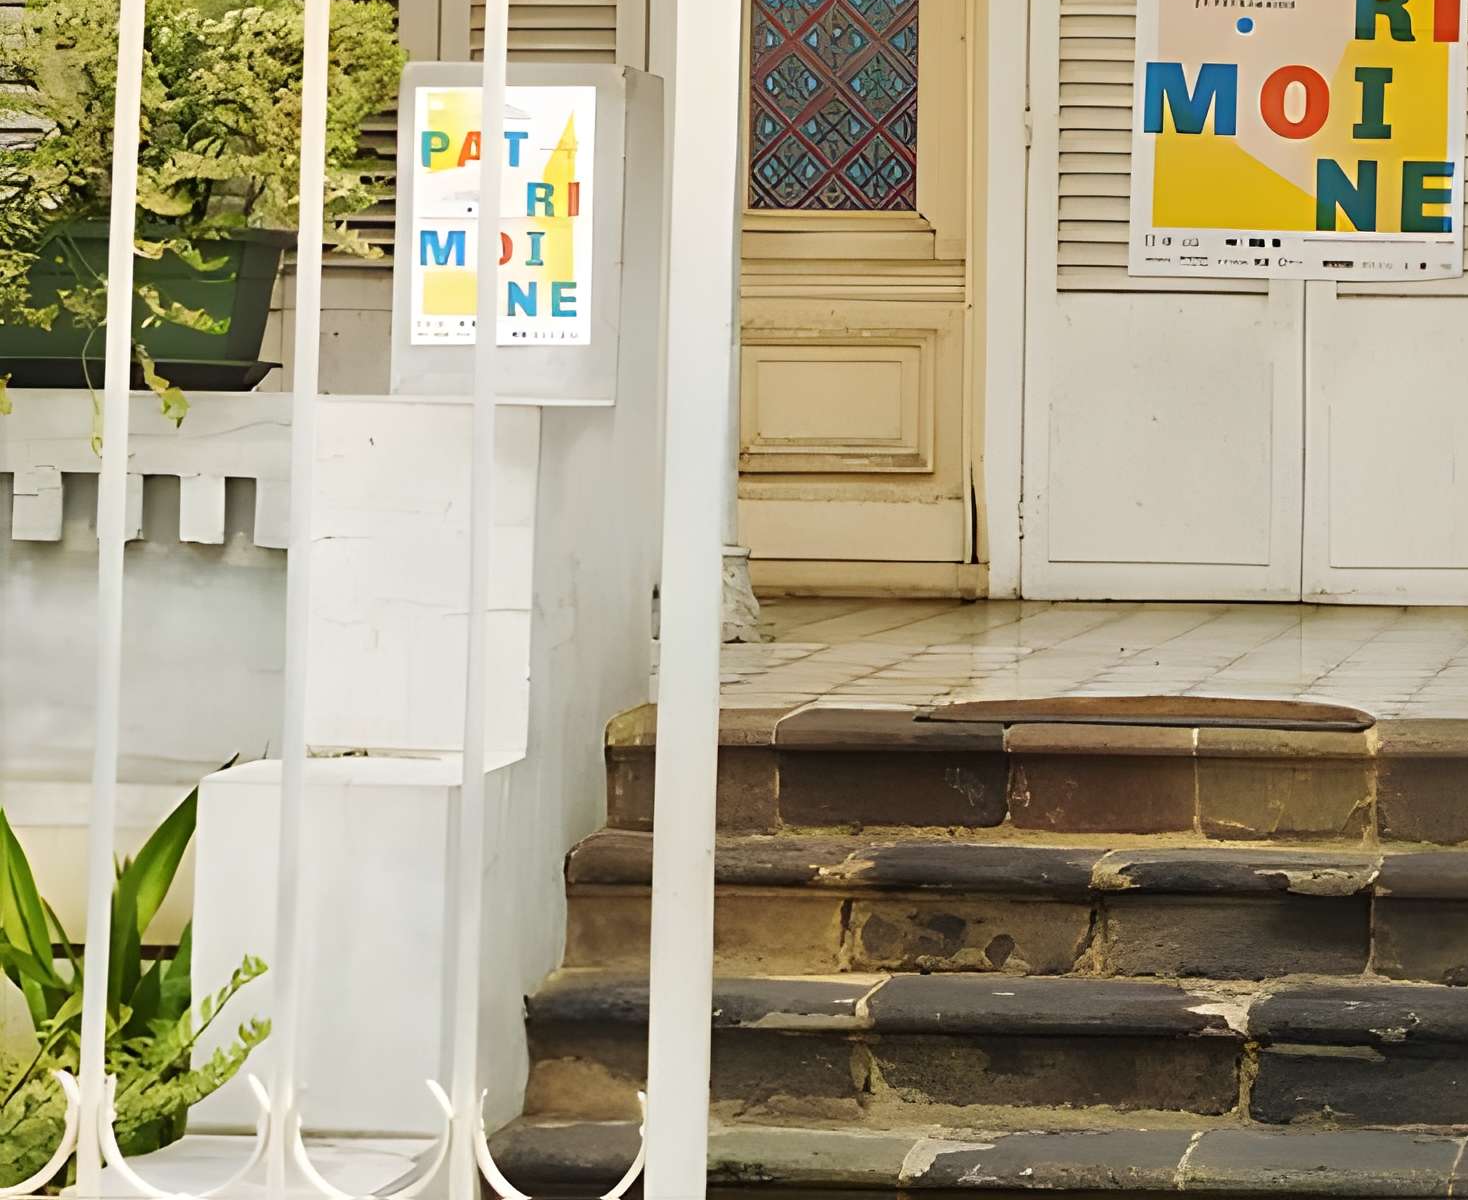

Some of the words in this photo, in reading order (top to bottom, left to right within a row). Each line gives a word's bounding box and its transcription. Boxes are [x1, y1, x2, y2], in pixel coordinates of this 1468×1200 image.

[1143, 61, 1393, 140] MOI
[421, 131, 528, 168] PAT
[527, 182, 580, 217] RI
[1315, 158, 1455, 233] NE
[507, 281, 577, 317] NE
